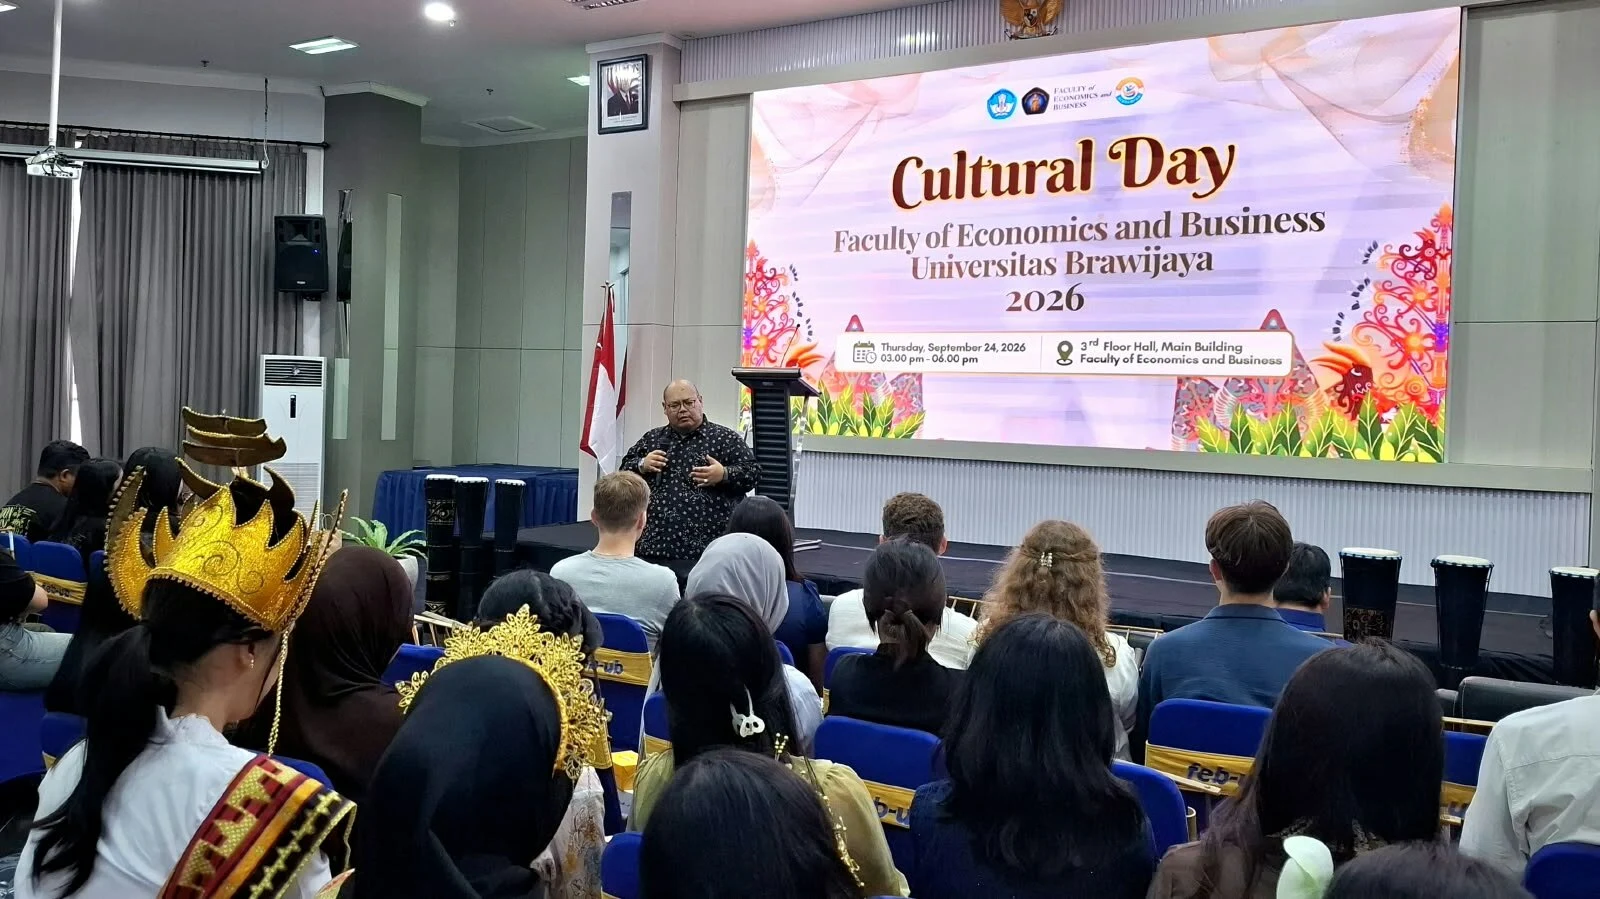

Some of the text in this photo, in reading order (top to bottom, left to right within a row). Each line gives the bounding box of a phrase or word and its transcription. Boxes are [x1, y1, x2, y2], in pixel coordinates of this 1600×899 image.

[1054, 86, 1086, 94] FACULTY
[1054, 93, 1098, 102] ECONOMICS
[1053, 102, 1087, 110] BUSINESS
[892, 136, 1236, 210] Cultural Day
[833, 206, 1326, 254] Faculty of Economics and Business
[911, 246, 1214, 280] Universitas Brawijaya
[1005, 283, 1085, 312] 2026
[881, 342, 1026, 354] Thursday, September 24, 2026
[1103, 341, 1131, 351] Floor
[1134, 341, 1158, 353] Hall,
[1161, 342, 1192, 352] Main
[1194, 342, 1243, 354] Building
[880, 354, 907, 362] 03.00
[909, 356, 924, 365] pm
[931, 354, 960, 363] 06.00
[962, 357, 978, 366] pm
[1080, 354, 1283, 366] Faculty of Economics and Business
[1187, 762, 1241, 785] feb-
